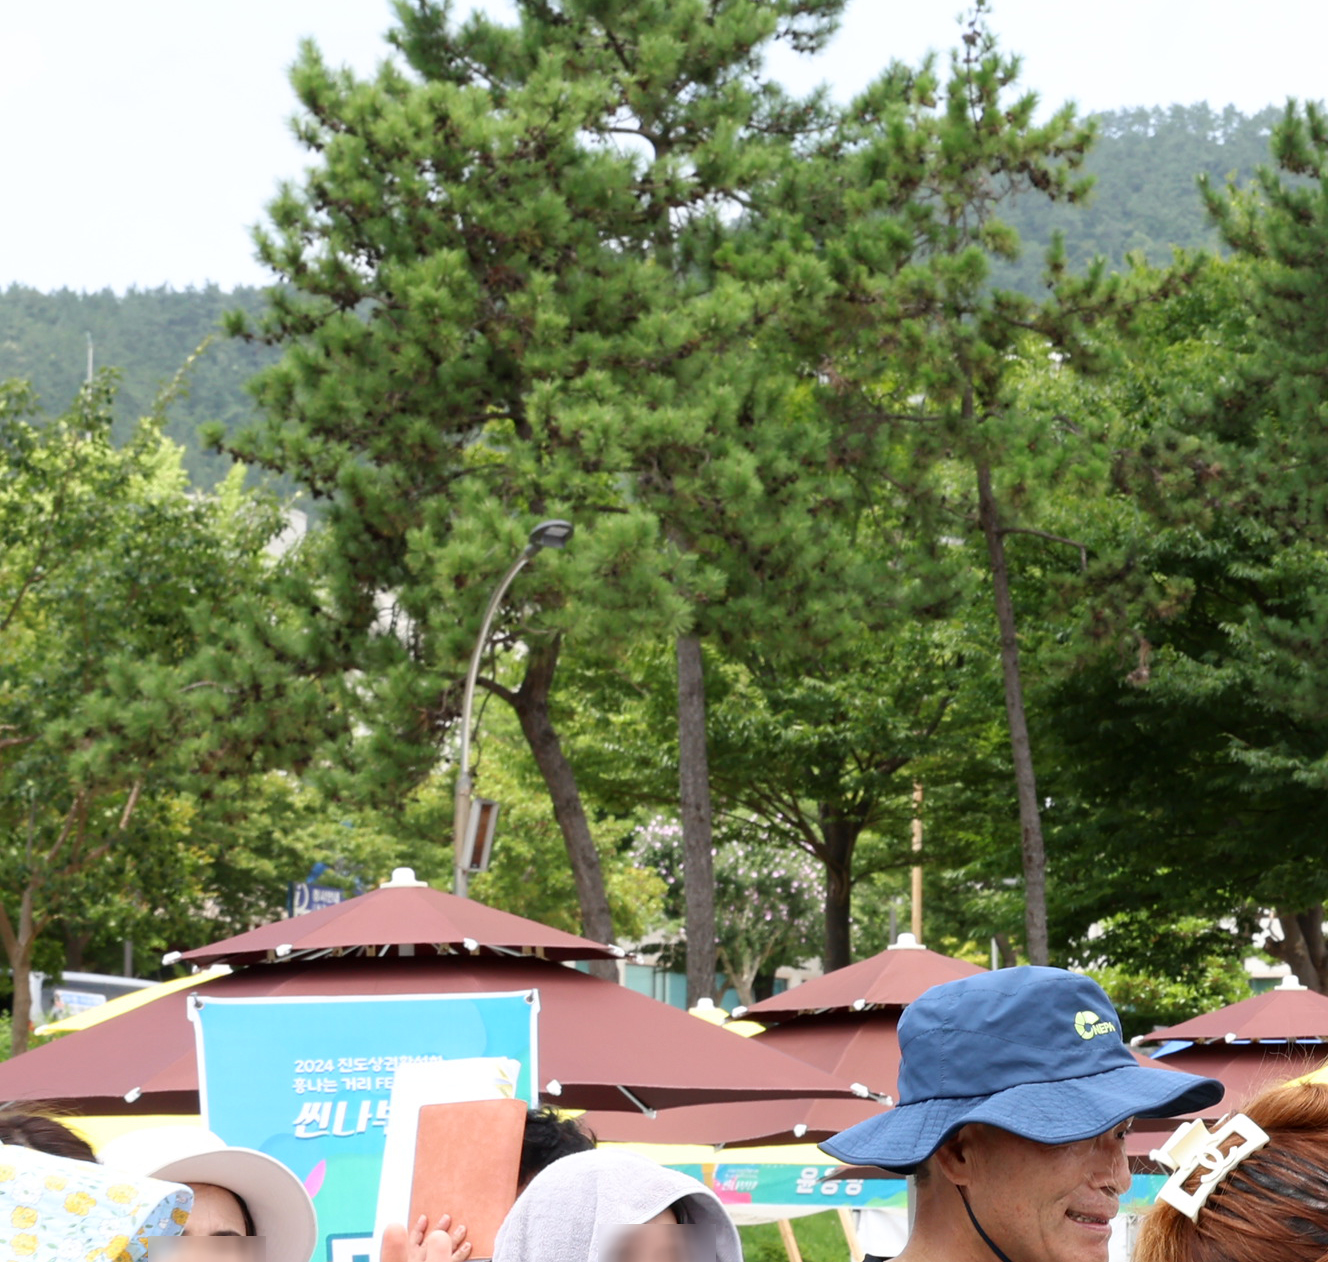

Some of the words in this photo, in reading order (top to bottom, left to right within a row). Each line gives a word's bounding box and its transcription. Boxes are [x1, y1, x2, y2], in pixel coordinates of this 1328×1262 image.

[294, 1059, 335, 1074] 2024
[292, 1077, 338, 1095] 흥나는
[340, 1076, 372, 1092] 거리
[293, 1099, 392, 1139] 씬나
